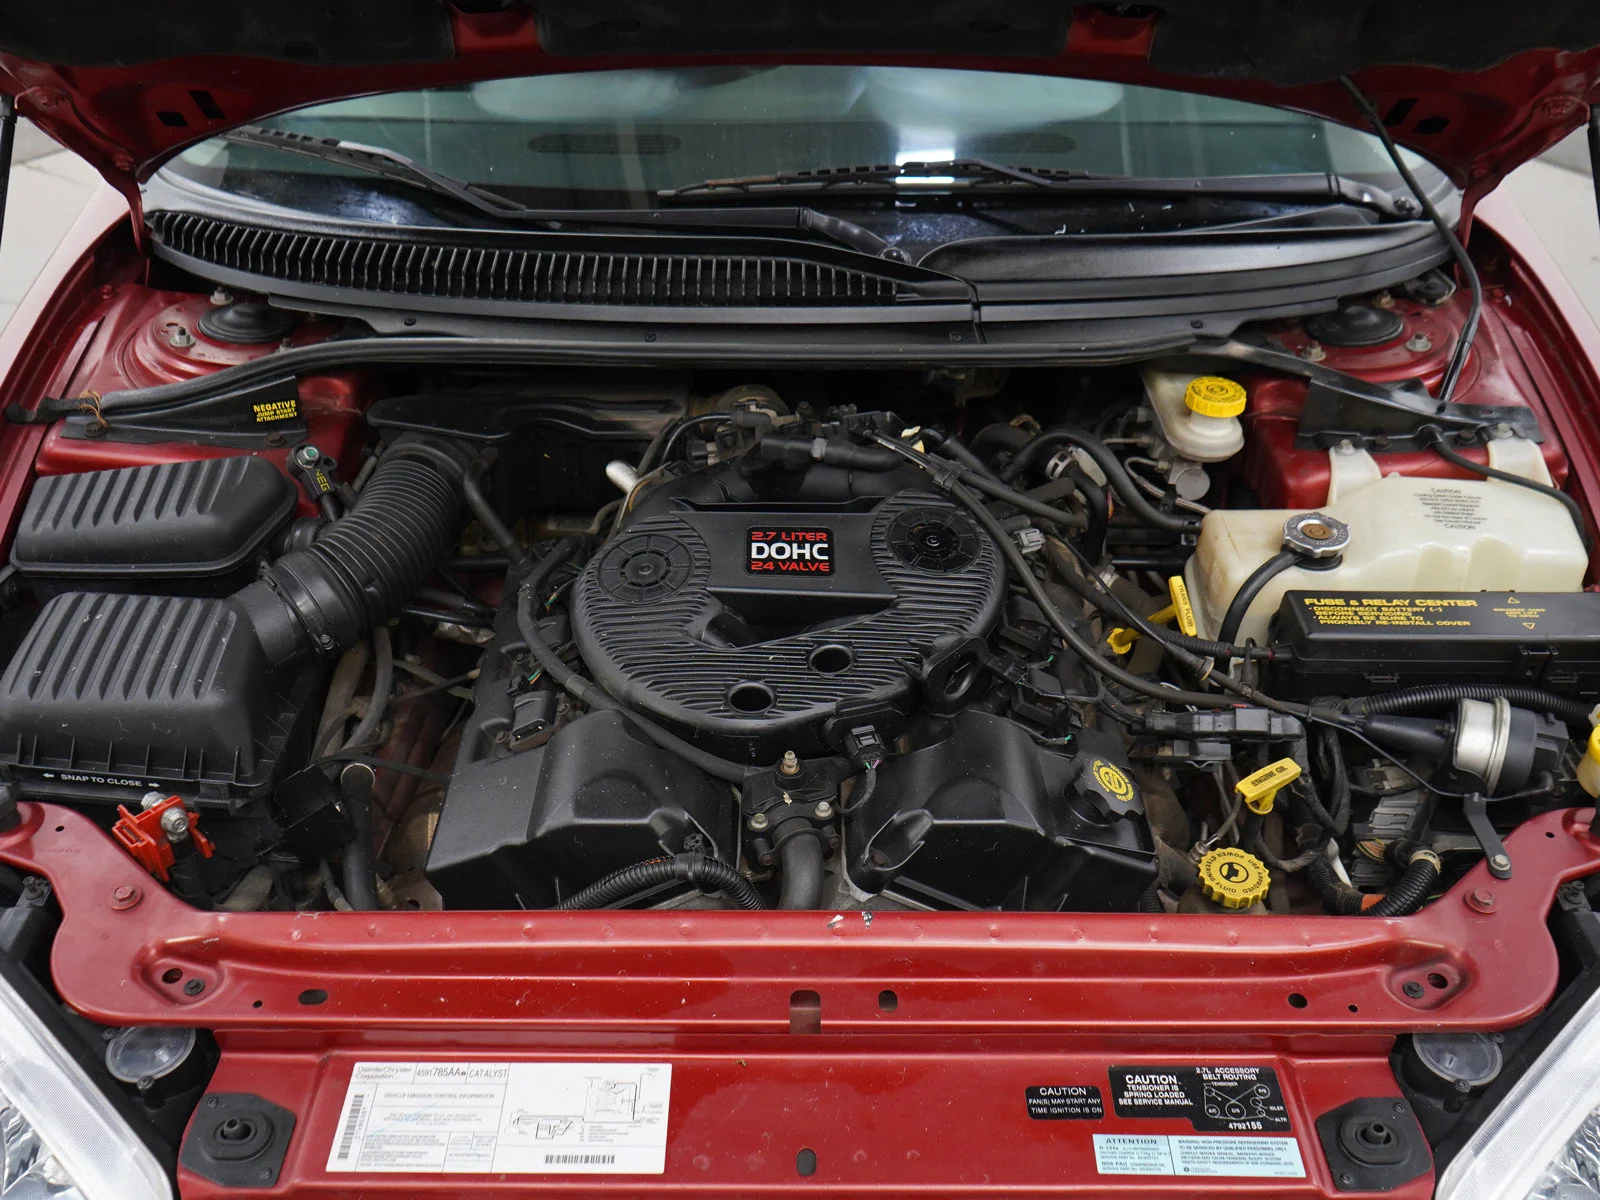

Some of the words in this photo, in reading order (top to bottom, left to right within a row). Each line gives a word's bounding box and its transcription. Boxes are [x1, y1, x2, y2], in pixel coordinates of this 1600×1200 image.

[253, 399, 297, 412] NEGATIVE
[256, 412, 298, 422] ATTACHMENT
[316, 469, 331, 492] NEG
[751, 531, 777, 541] 2.7
[781, 532, 828, 542] LITER
[751, 542, 829, 560] DOHC
[750, 561, 775, 571] 24
[777, 561, 830, 572] VALVE
[1177, 584, 1189, 606] TRANS
[1184, 608, 1194, 627] FLUID
[1304, 598, 1346, 606] FUSE
[1361, 598, 1411, 606] RELAY
[1415, 599, 1478, 607] CENTER
[60, 773, 89, 782] SNAP
[107, 778, 143, 787] CLOSE
[1251, 770, 1277, 786] ENGINE
[1275, 765, 1288, 773] OIL
[1216, 851, 1245, 859] POWER
[1205, 855, 1217, 882] STEERING
[1247, 859, 1260, 870] USE
[1215, 881, 1237, 893] FLUID
[1242, 871, 1264, 894] APPROVED
[469, 1069, 508, 1078] CATALYST
[1125, 1074, 1178, 1085] CAUTION
[1039, 1087, 1087, 1096] CAUTION
[1154, 1091, 1185, 1099] LOADED
[1028, 1098, 1050, 1106] FAN(S)
[1118, 1098, 1133, 1106] SEE
[1133, 1098, 1163, 1106] SERVICE
[1164, 1098, 1193, 1106] MANUAL
[1228, 1121, 1263, 1130] 4792155
